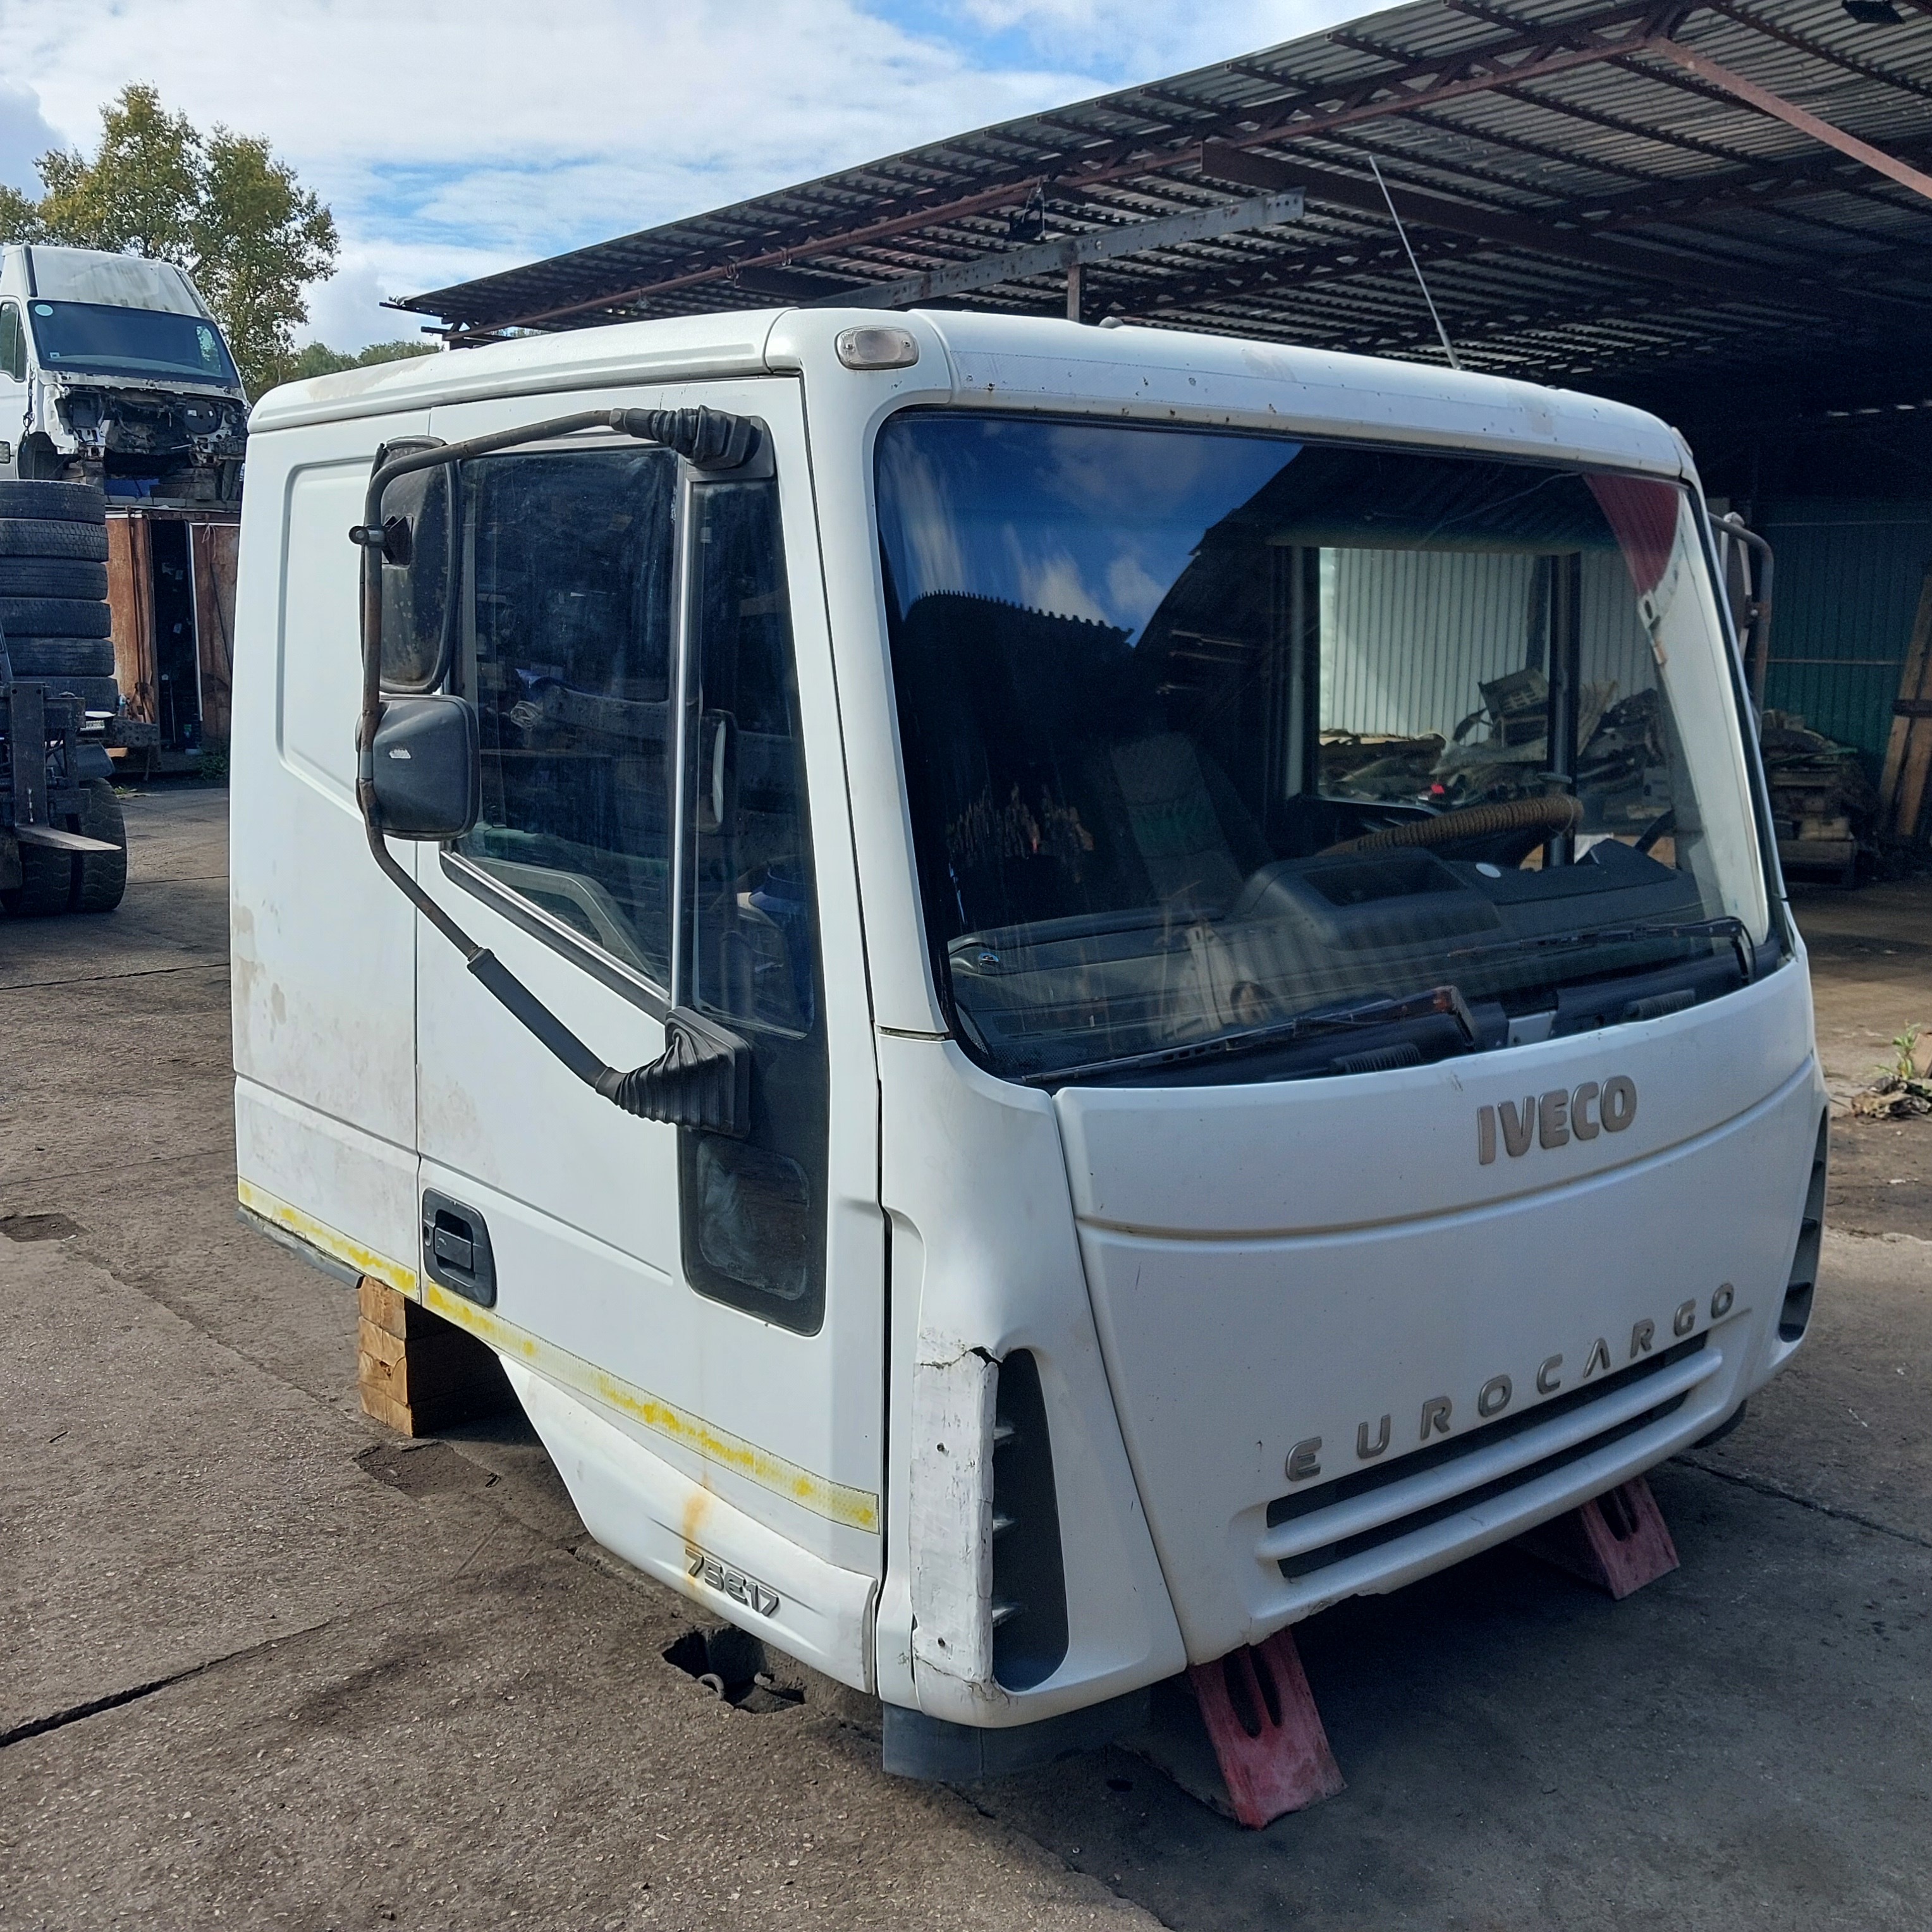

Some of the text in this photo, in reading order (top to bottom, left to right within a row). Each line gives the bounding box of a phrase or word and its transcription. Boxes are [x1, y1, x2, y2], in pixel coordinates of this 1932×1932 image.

[1477, 1075, 1637, 1165] IVECO
[1285, 1282, 1735, 1482] EUROCARGO
[685, 1548, 780, 1617] 75E17
